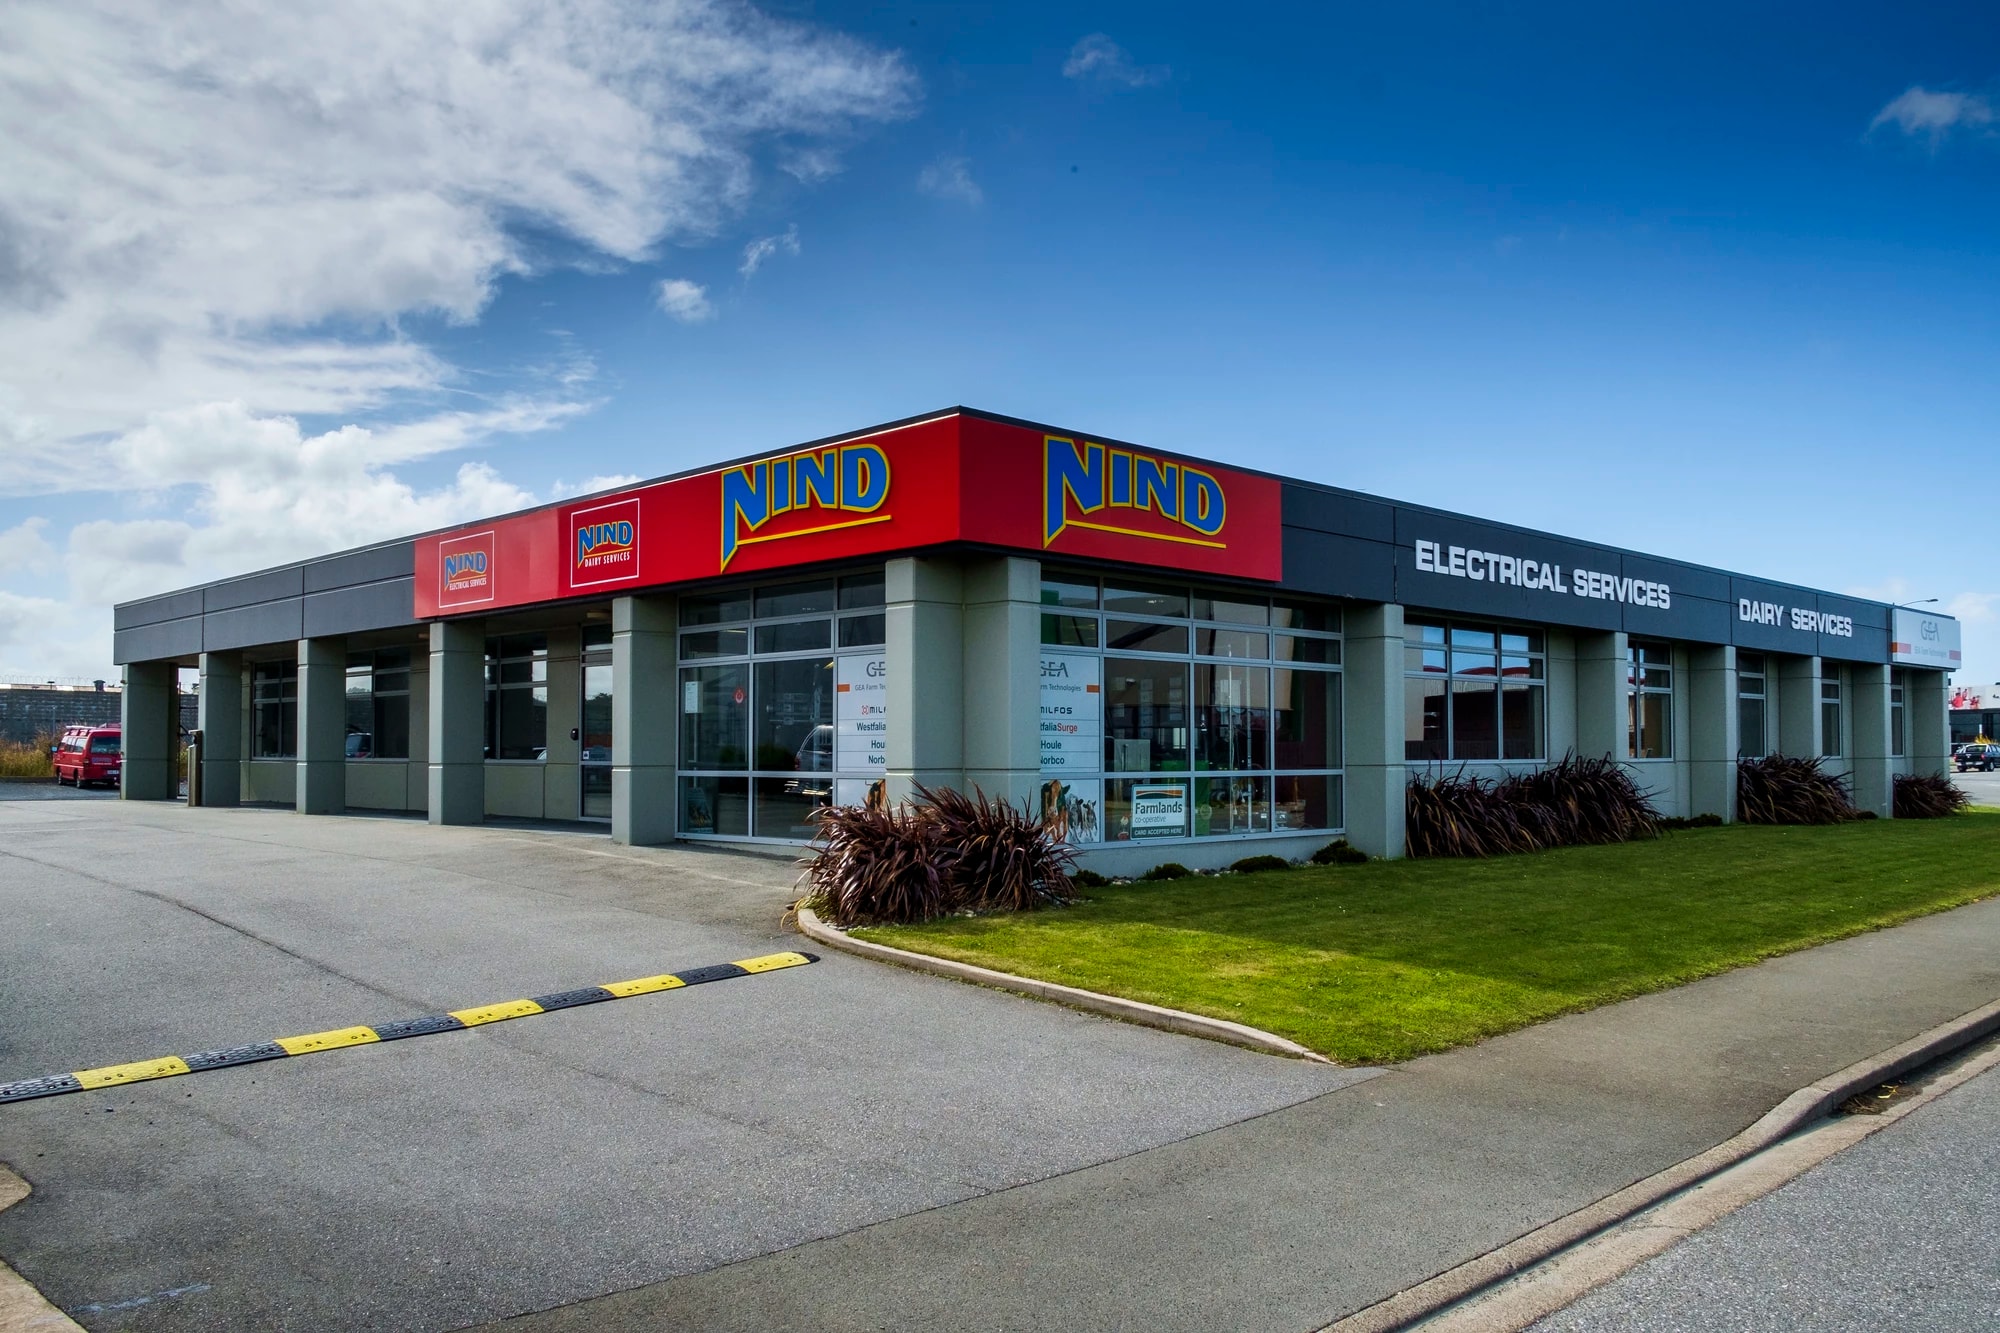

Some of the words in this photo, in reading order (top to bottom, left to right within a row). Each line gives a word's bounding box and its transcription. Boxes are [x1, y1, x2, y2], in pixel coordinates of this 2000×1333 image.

[1043, 435, 1226, 549] NIND
[720, 443, 891, 573] NIND
[577, 520, 633, 569] NIND
[584, 556, 601, 568] DAIRY
[603, 551, 631, 564] SERVICES
[444, 551, 488, 592] NIND
[1415, 539, 1568, 594] ELECTRICAL
[1572, 569, 1671, 610] SERVICES
[449, 580, 470, 591] ELECTRICAL
[469, 577, 487, 588] SERVICES
[1739, 598, 1784, 627] DAIRY
[1791, 607, 1853, 638] SERVICES
[1921, 620, 1940, 642] GEA
[866, 661, 886, 677] GE
[1049, 684, 1081, 693] Technologies
[857, 722, 886, 731] Westfalia
[871, 740, 885, 749] Hou
[1041, 740, 1062, 749] Houle
[868, 755, 885, 764] Norb
[1135, 801, 1183, 814] Farmlands
[1135, 815, 1167, 824] co-operative
